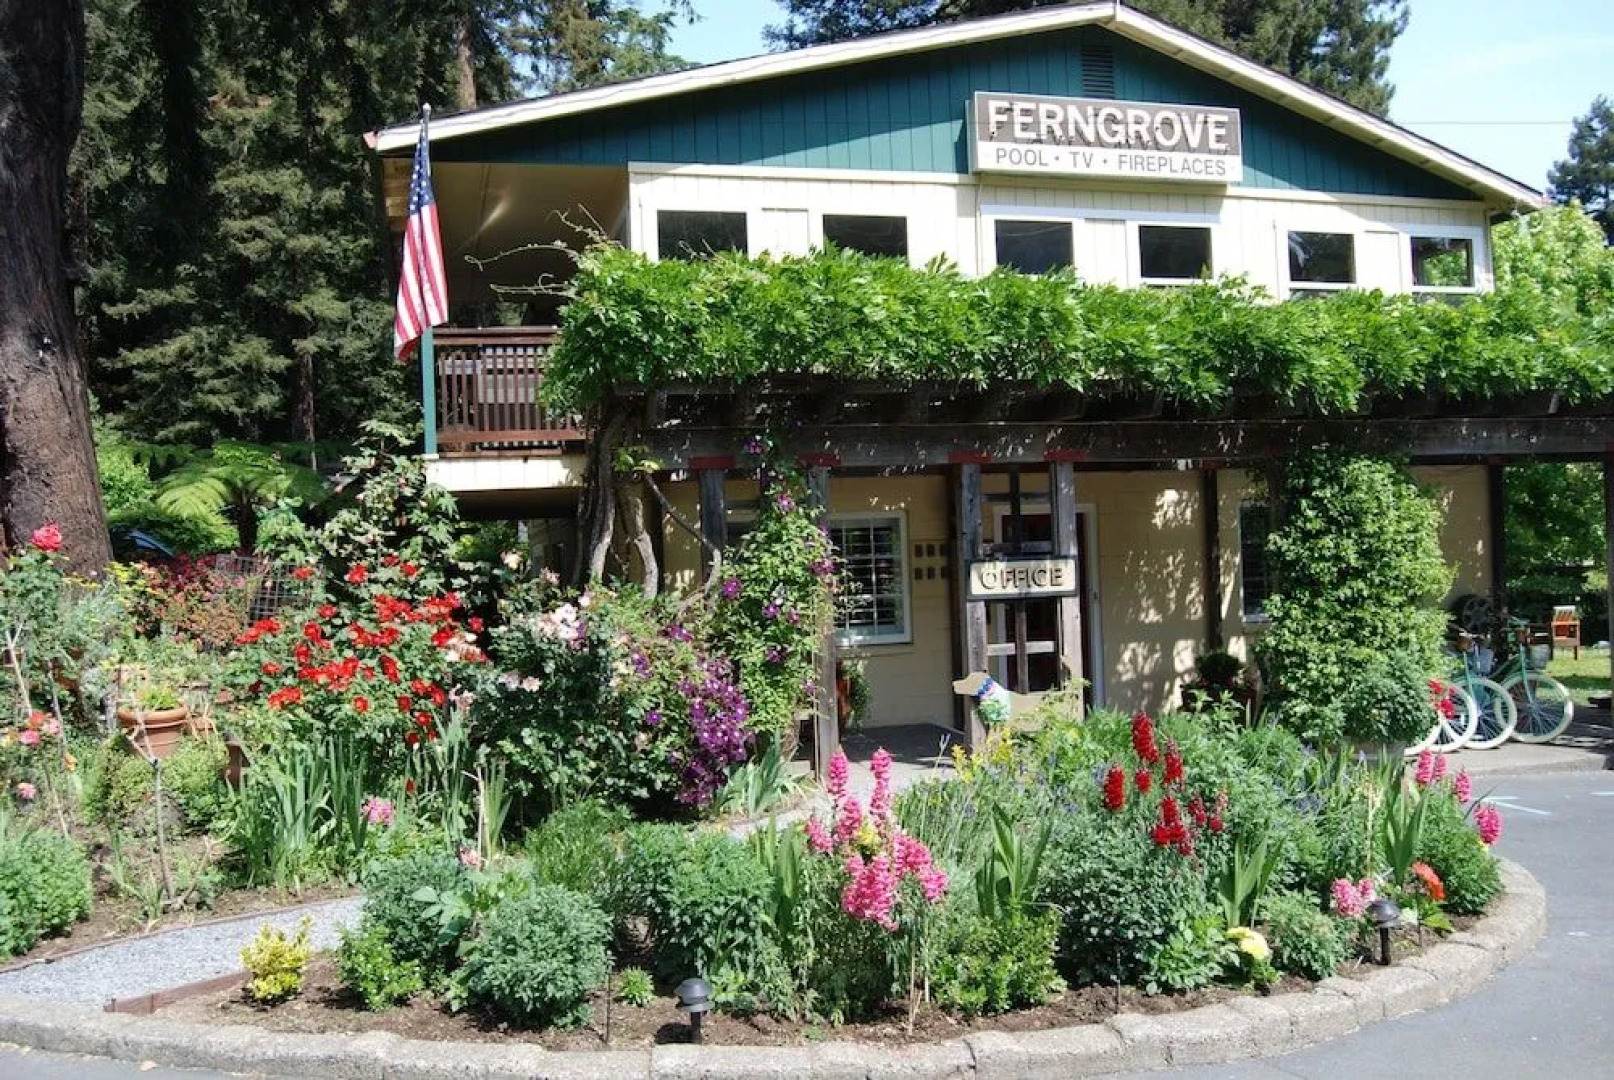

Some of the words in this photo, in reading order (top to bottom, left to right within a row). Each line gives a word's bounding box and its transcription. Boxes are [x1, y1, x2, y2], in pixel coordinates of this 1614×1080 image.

[988, 101, 1229, 150] FERNGROVE
[996, 148, 1048, 167] POOL
[1070, 151, 1094, 169] TV
[1118, 154, 1226, 176] FIREPLACES
[980, 566, 1063, 589] OFFICE
